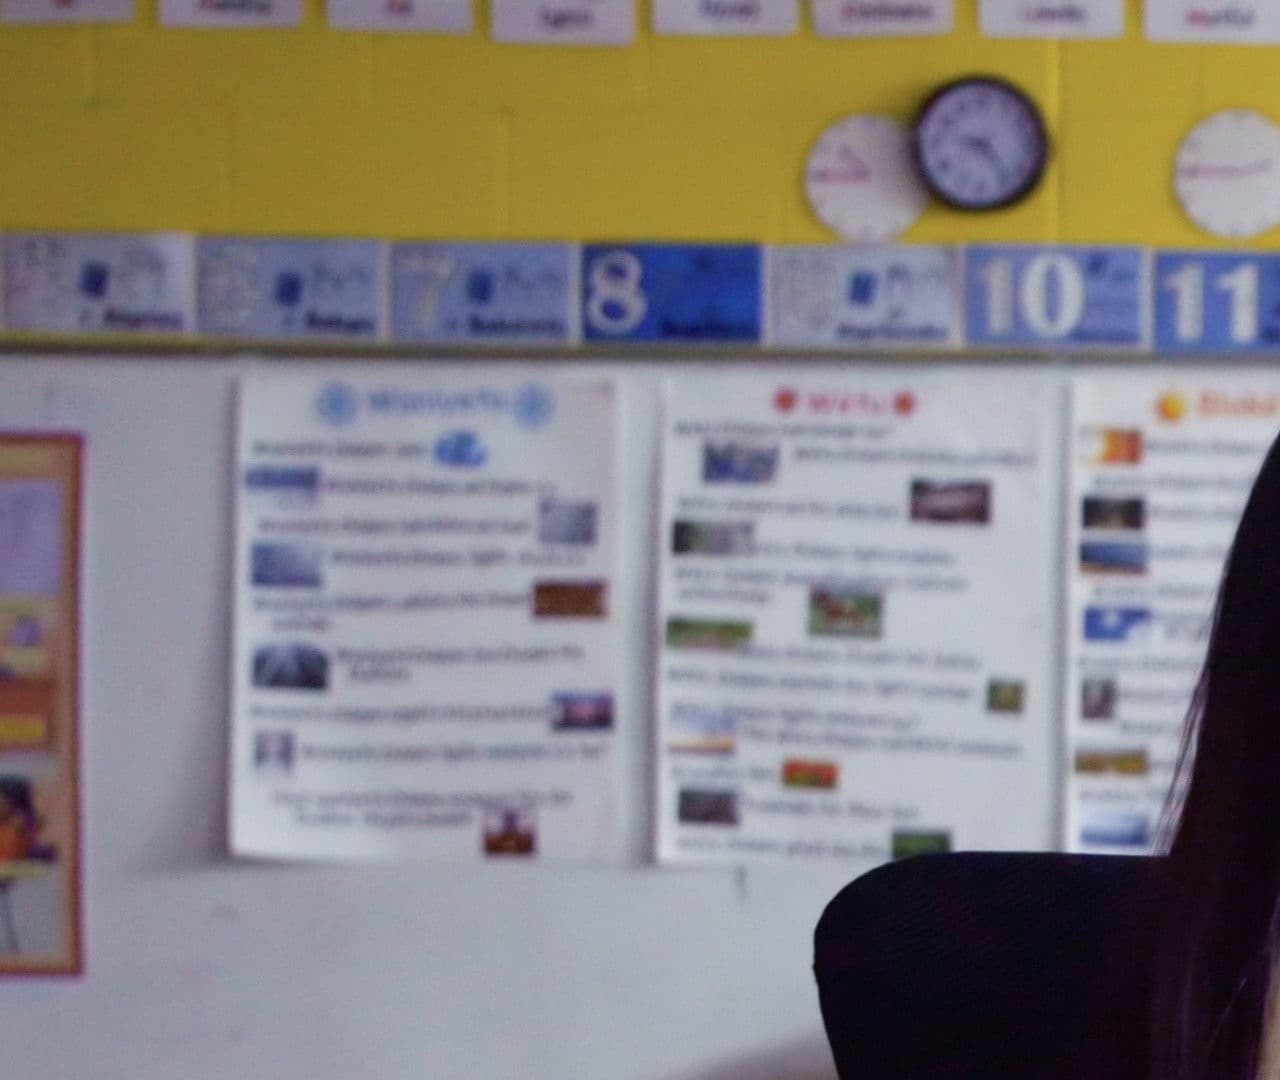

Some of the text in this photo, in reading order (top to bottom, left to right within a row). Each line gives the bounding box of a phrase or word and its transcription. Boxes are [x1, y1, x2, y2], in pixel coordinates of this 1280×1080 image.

[585, 249, 648, 336] 8
[979, 253, 1086, 338] 10
[1164, 262, 1260, 346] 11
